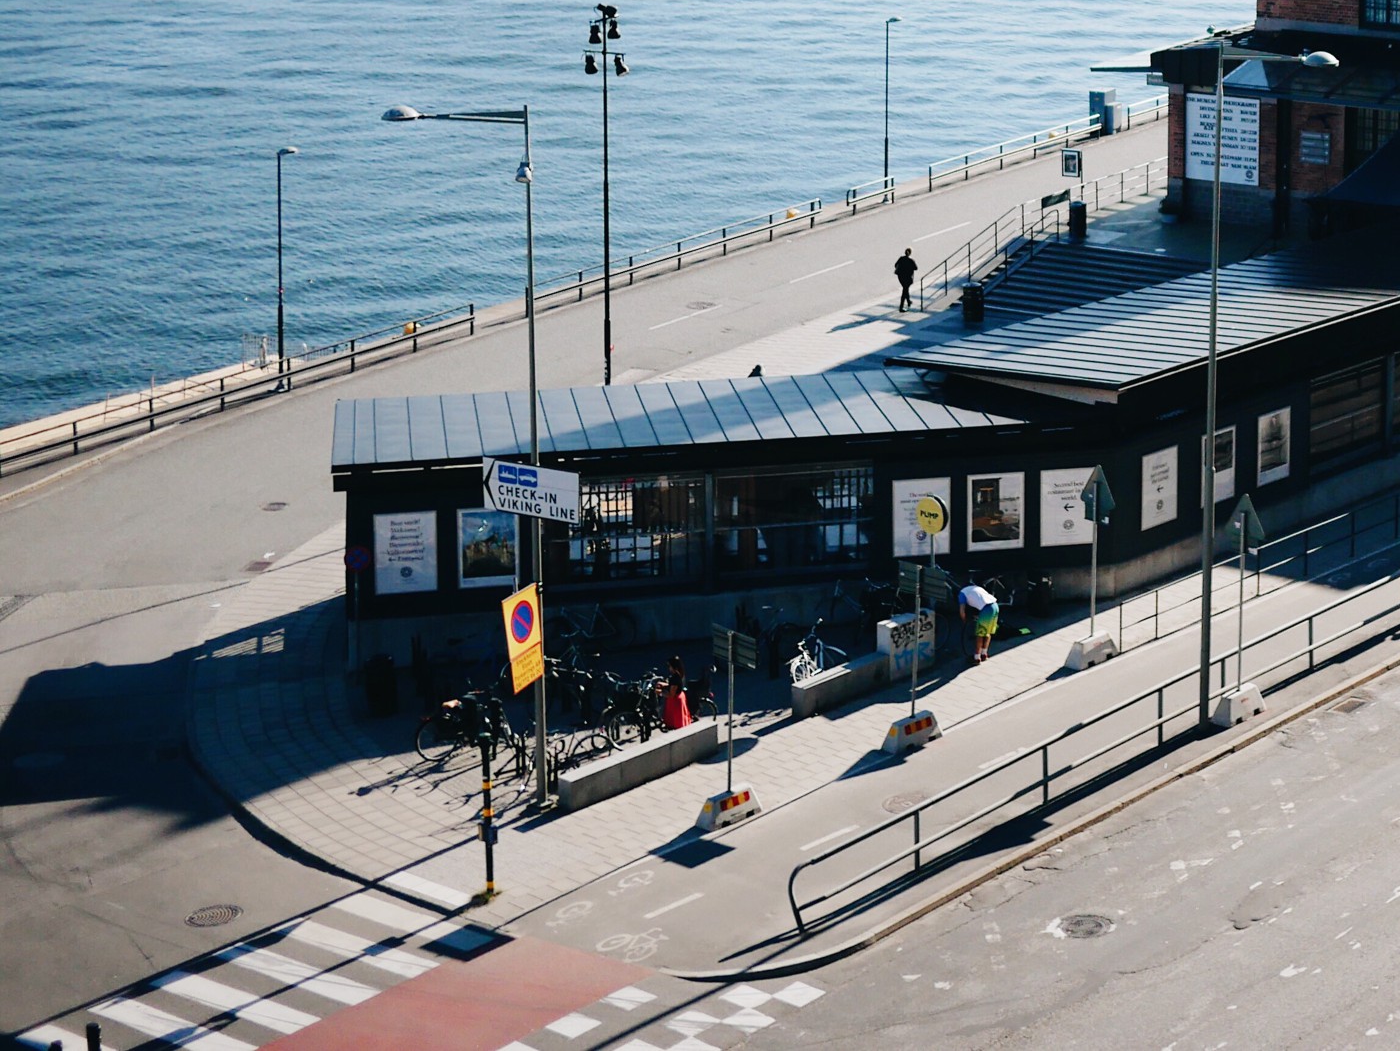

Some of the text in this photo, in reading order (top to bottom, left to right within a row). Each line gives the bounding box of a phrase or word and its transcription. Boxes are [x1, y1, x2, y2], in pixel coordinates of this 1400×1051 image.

[498, 485, 557, 504] CHECK-IN
[498, 497, 576, 520] VIKING LINE
[920, 510, 939, 519] PUMP
